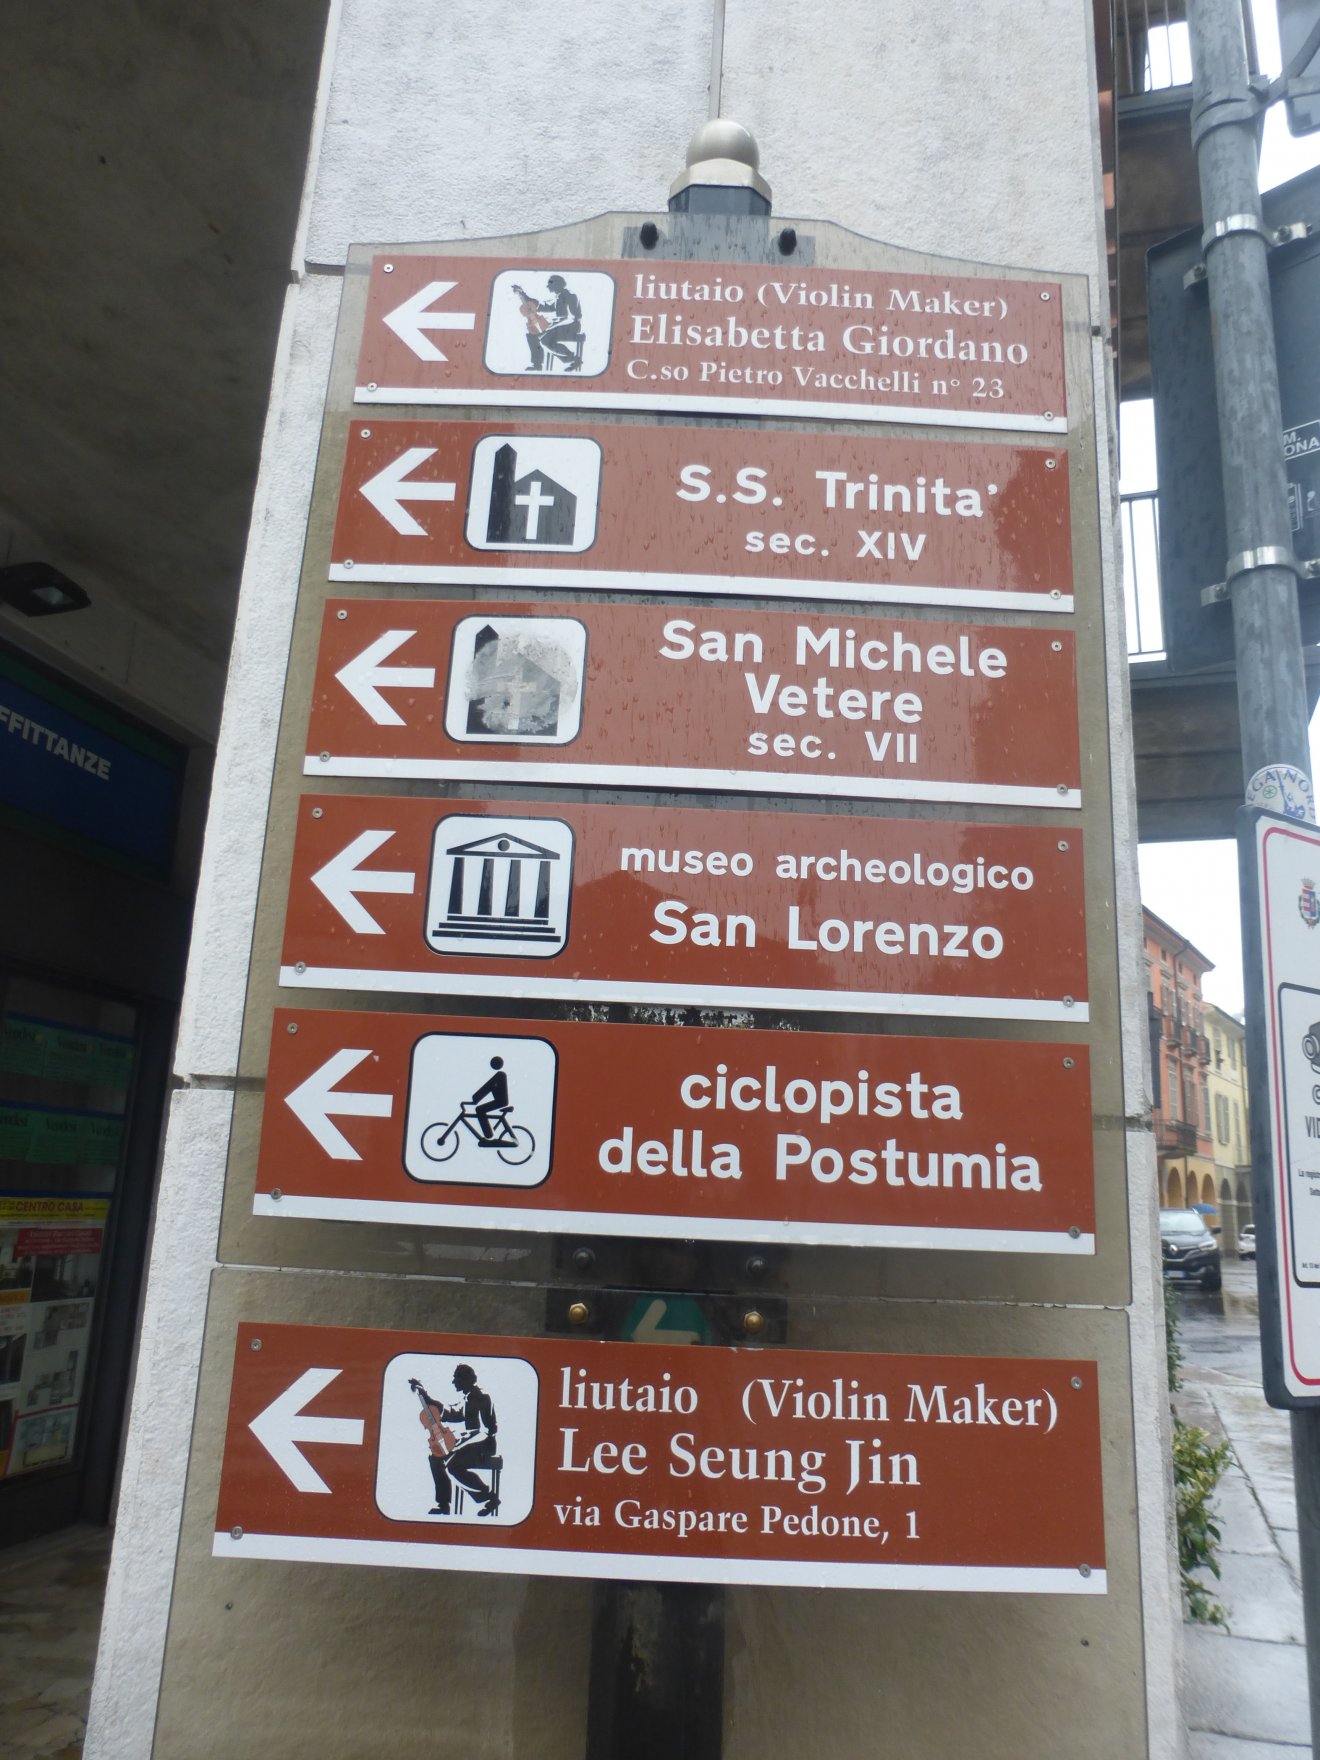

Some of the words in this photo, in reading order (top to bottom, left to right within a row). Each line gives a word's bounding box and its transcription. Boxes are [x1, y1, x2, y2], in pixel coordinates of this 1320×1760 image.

[633, 273, 744, 303] liutaio
[757, 281, 874, 309] (Violin
[885, 288, 1008, 321] Maker)
[629, 313, 826, 352] Elisabetta
[842, 324, 1028, 365] Giordano
[626, 359, 689, 381] C.so
[700, 361, 783, 385] Pietro
[791, 366, 921, 394] Vacchelli
[972, 377, 1004, 399] 23
[676, 464, 783, 507] S.S.
[744, 530, 829, 557] sec.
[856, 530, 927, 561] XIV
[658, 619, 763, 663] San
[796, 625, 1008, 678] Michele
[744, 672, 923, 724] Vetere
[747, 732, 836, 760] sec.
[864, 730, 917, 764] VII
[620, 847, 754, 877] museo
[775, 849, 1034, 894] archeologico
[649, 900, 756, 948] San
[788, 905, 1004, 960] Lorenzo
[680, 1063, 964, 1124] ciclopista
[598, 1126, 743, 1180] della
[775, 1133, 1043, 1192] Postumia
[15, 1201, 55, 1213] CENTRO
[57, 1201, 85, 1213] CASA
[558, 1366, 698, 1414] liutaio
[742, 1378, 890, 1425] (Violin
[903, 1383, 1058, 1432] Maker)
[557, 1427, 648, 1476] Lee
[669, 1432, 827, 1495] Seung
[845, 1438, 921, 1496] Jin
[553, 1495, 601, 1527] via
[614, 1499, 749, 1538] Gaspare
[760, 1504, 889, 1545] Pedone,
[905, 1510, 920, 1539] 1
